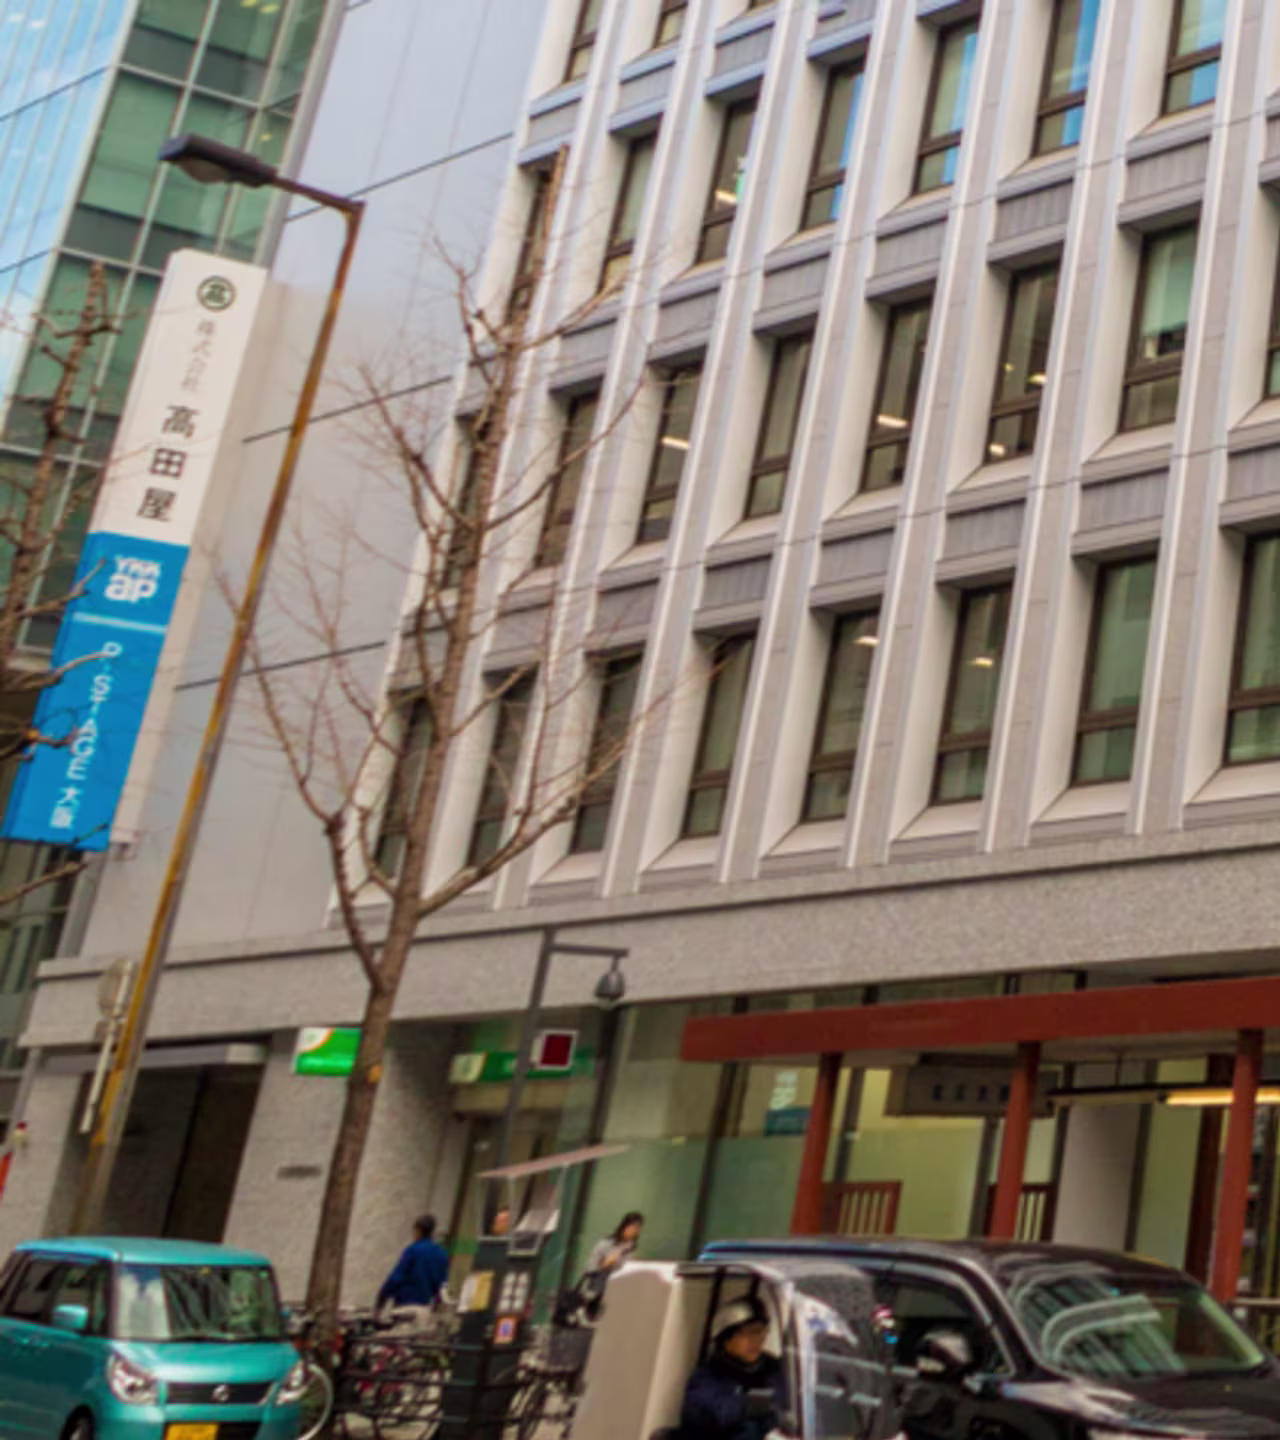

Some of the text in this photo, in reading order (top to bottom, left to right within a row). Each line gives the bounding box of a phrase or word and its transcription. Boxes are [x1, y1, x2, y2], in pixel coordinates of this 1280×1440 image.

[136, 405, 200, 523] 高田屋
[103, 572, 158, 603] ap
